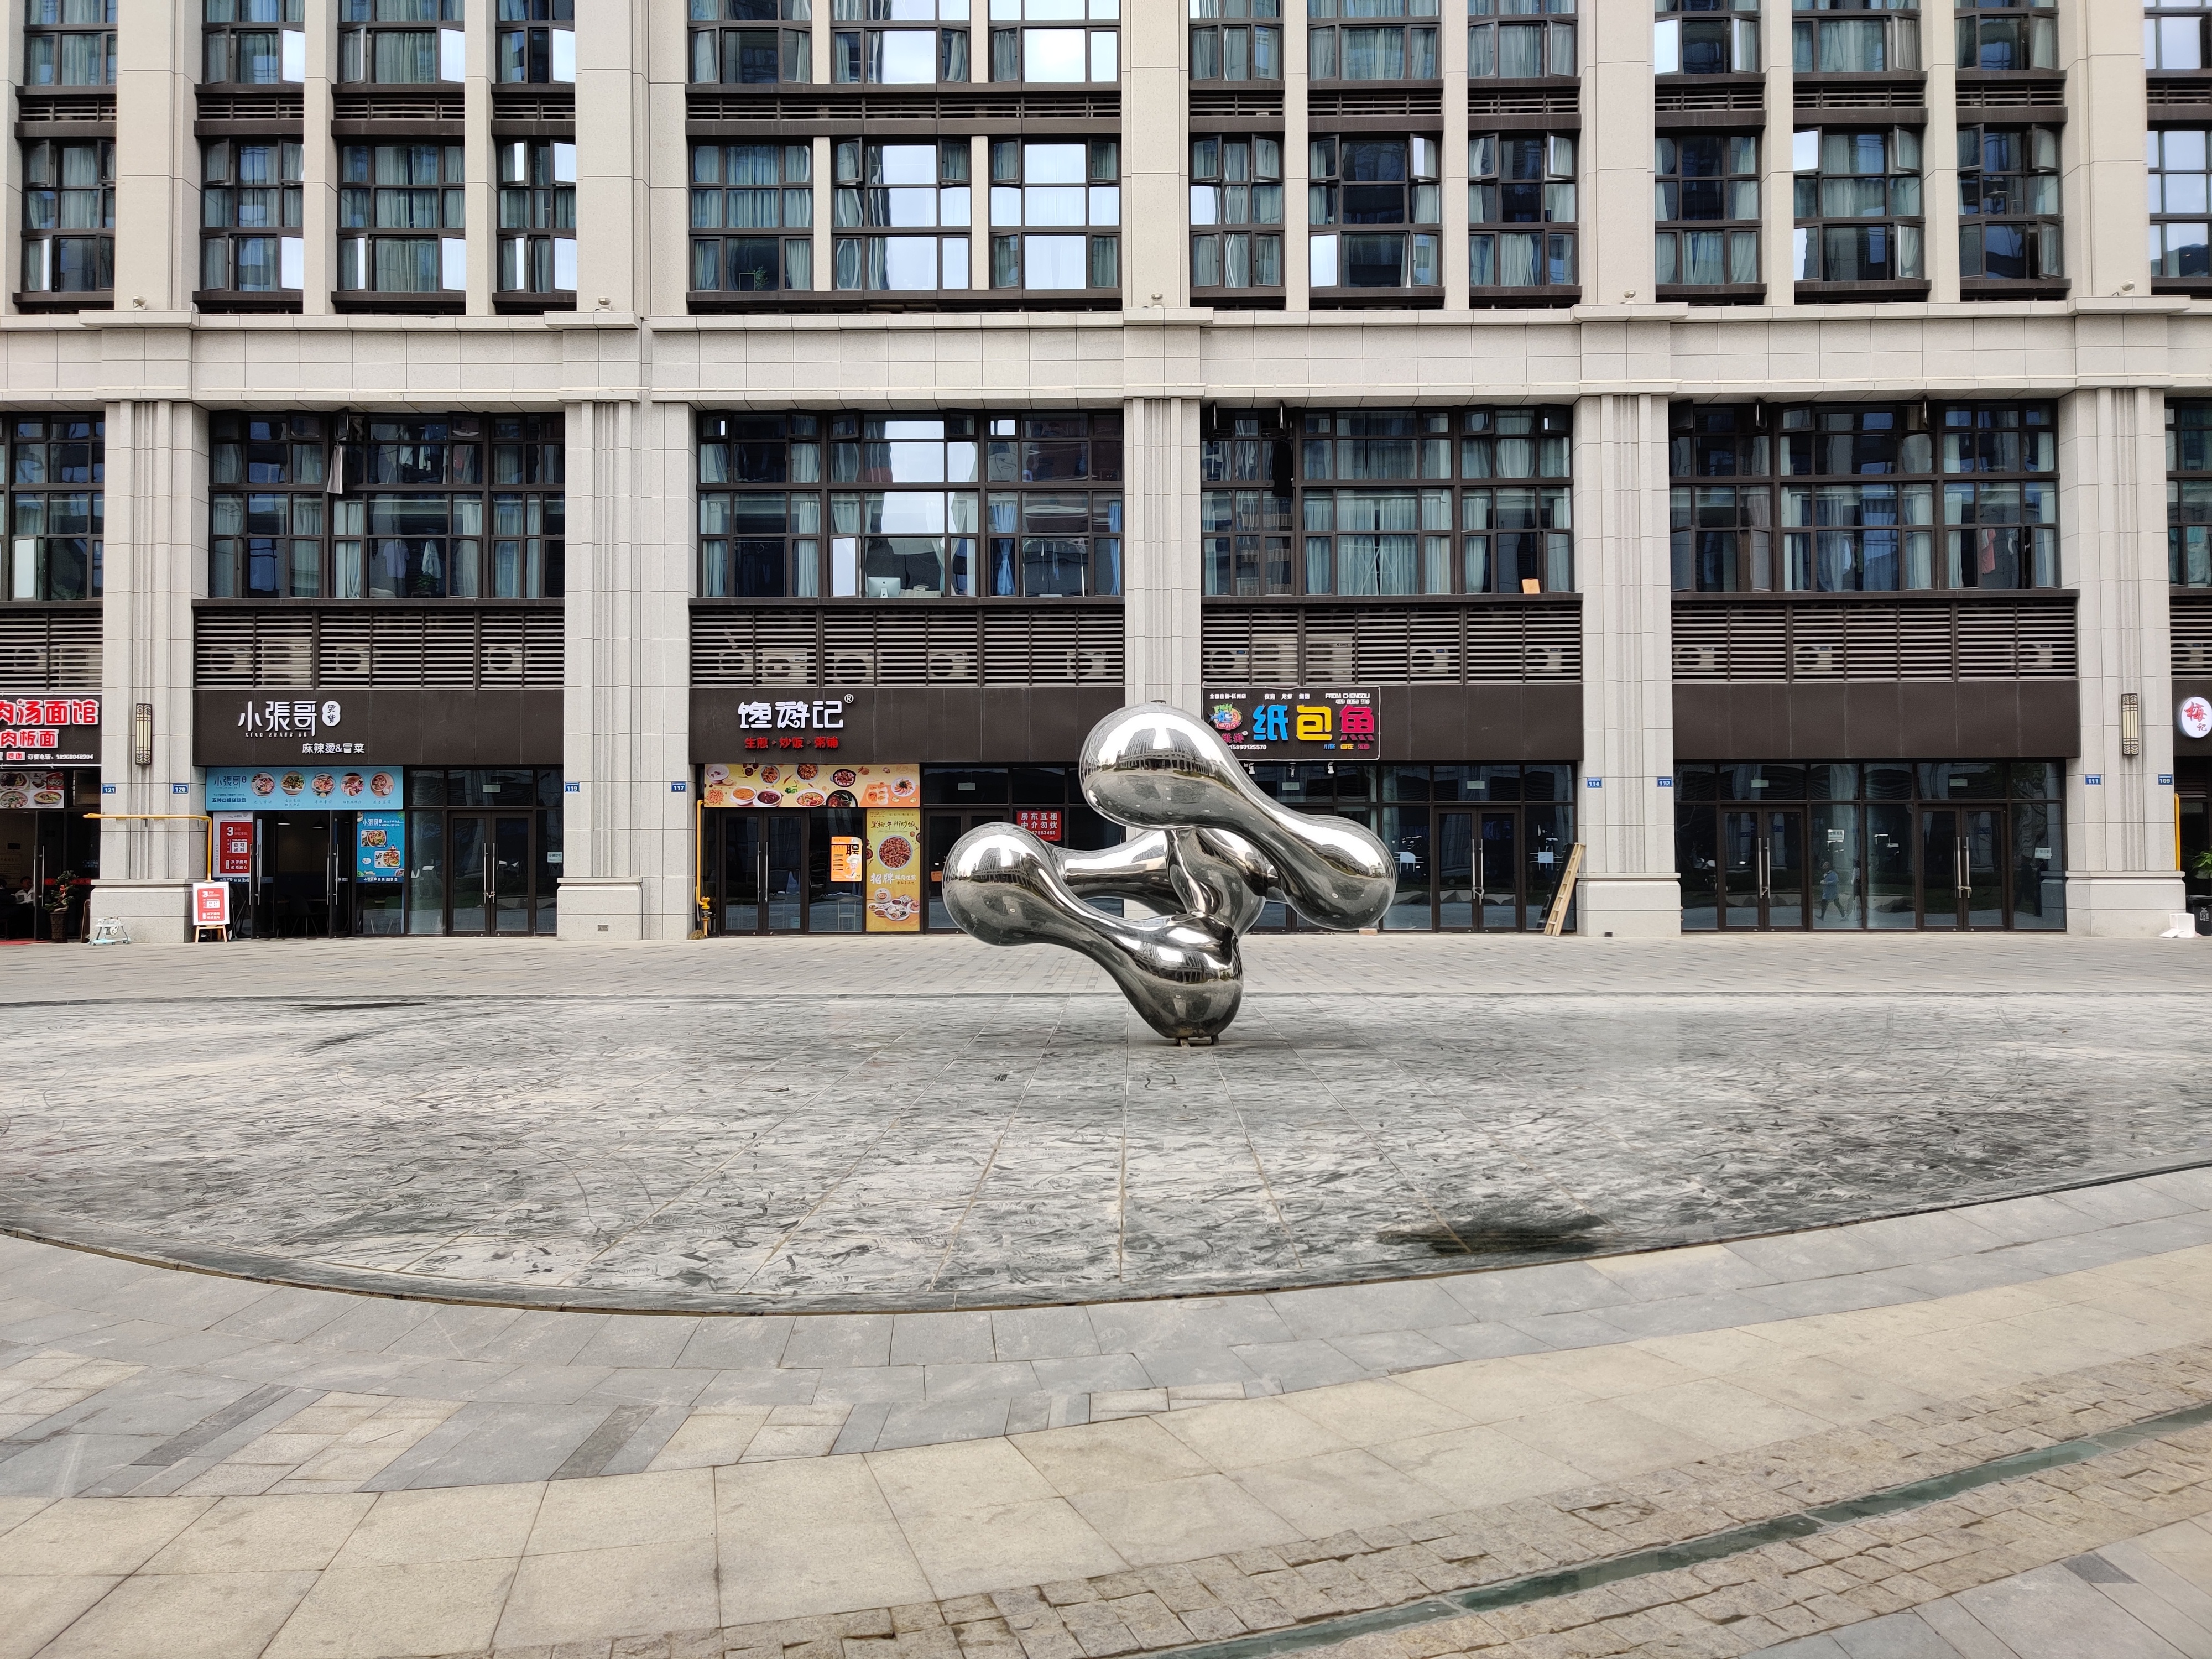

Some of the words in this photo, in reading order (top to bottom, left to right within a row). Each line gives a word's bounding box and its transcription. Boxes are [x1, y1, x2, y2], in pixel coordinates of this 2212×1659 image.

[0, 698, 100, 726] 肉汤面馆
[0, 729, 59, 748] 肉板面
[1021, 812, 1058, 821] 房东直租
[226, 826, 234, 836] 3
